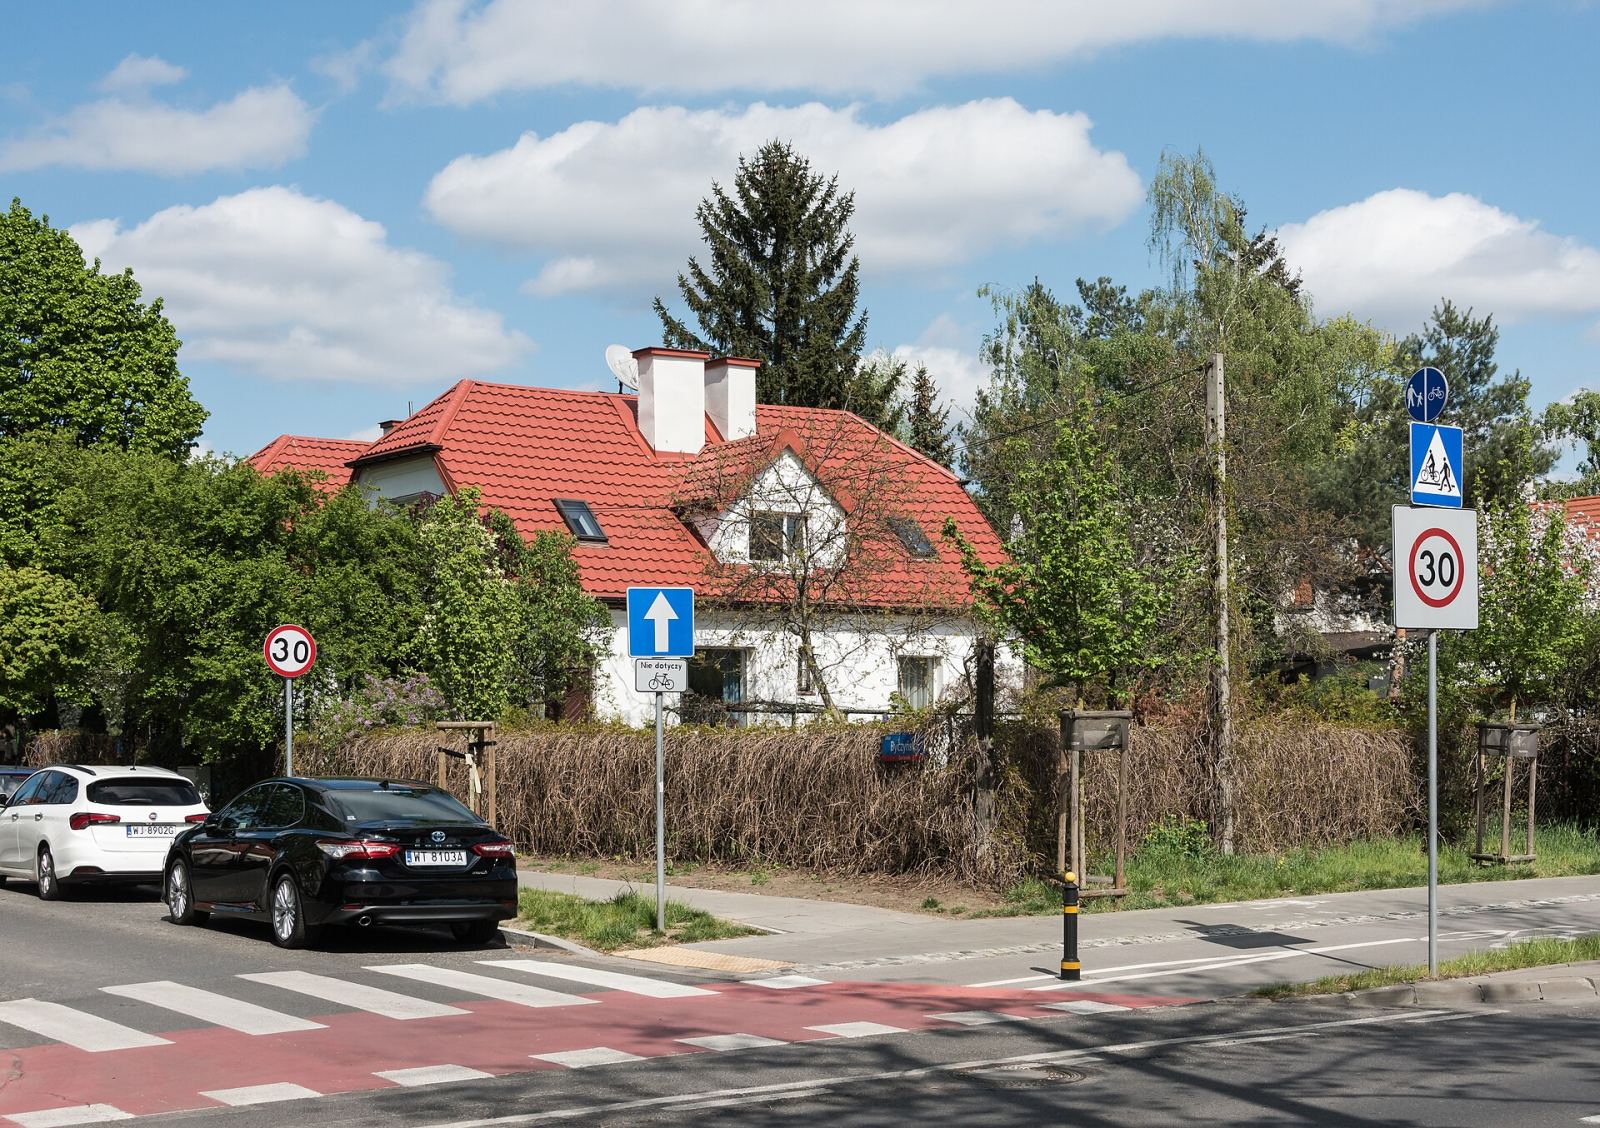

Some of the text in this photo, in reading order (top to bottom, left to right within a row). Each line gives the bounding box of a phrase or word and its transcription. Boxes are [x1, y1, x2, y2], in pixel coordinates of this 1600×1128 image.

[1419, 550, 1454, 587] 30
[272, 637, 309, 663] 30
[655, 662, 682, 671] dotyczy
[133, 826, 174, 835] WJ 8902G
[413, 851, 464, 862] WT 8103A
